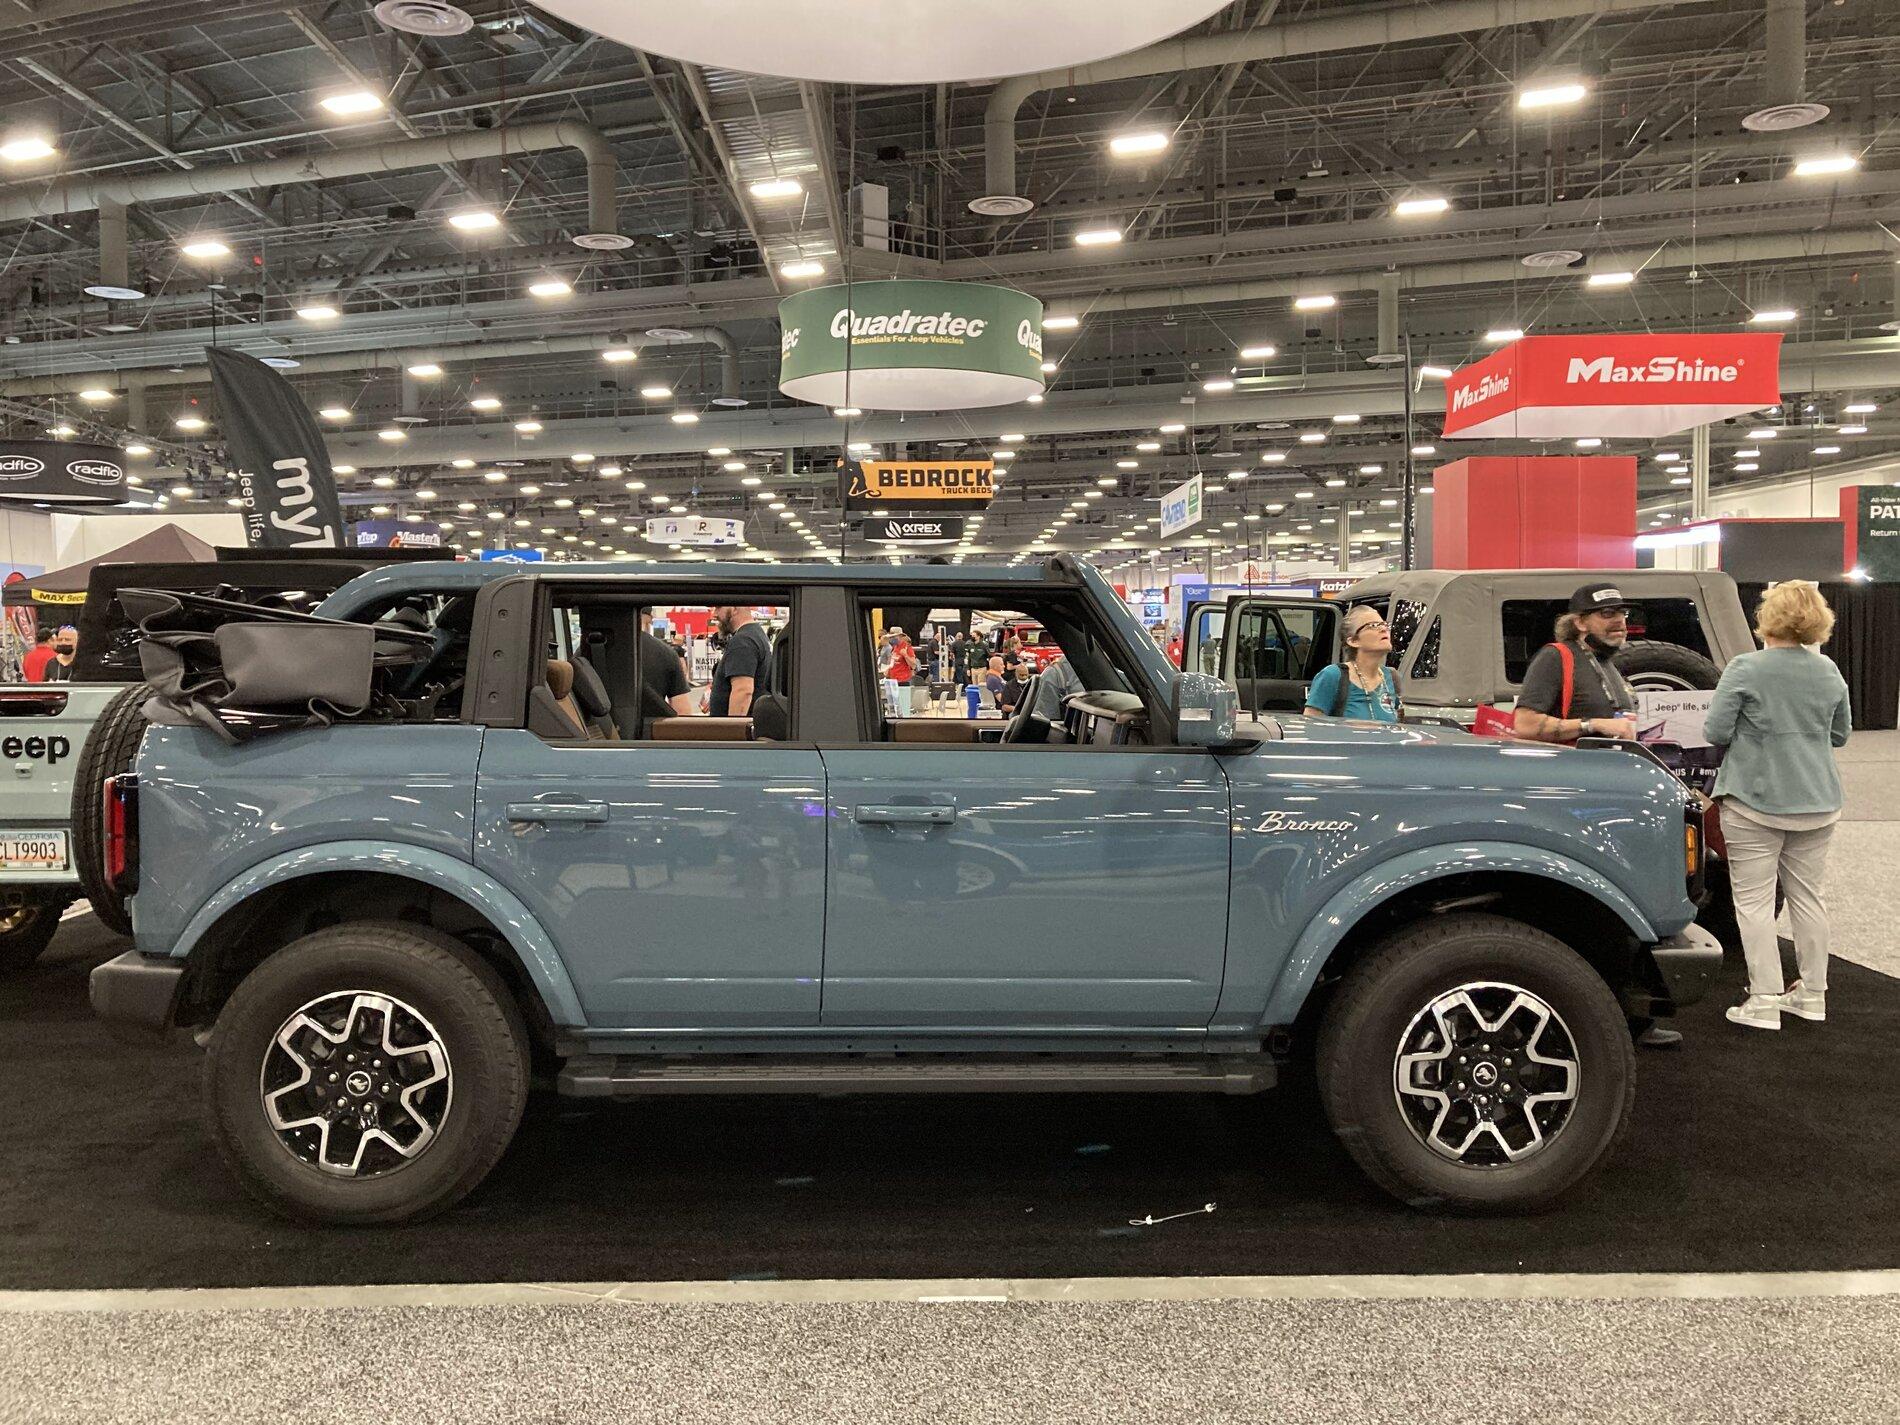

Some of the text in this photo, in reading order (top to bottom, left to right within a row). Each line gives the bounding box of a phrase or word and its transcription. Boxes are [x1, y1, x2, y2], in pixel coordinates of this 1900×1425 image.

[830, 308, 985, 339] Quadratec
[851, 335, 964, 345] Essentials For Jeep Vehicles
[75, 465, 119, 477] radflo
[879, 469, 991, 487] BEDROCK
[40, 593, 64, 602] MAX
[1682, 703, 1700, 712] life,
[1252, 811, 1353, 832] Bronco
